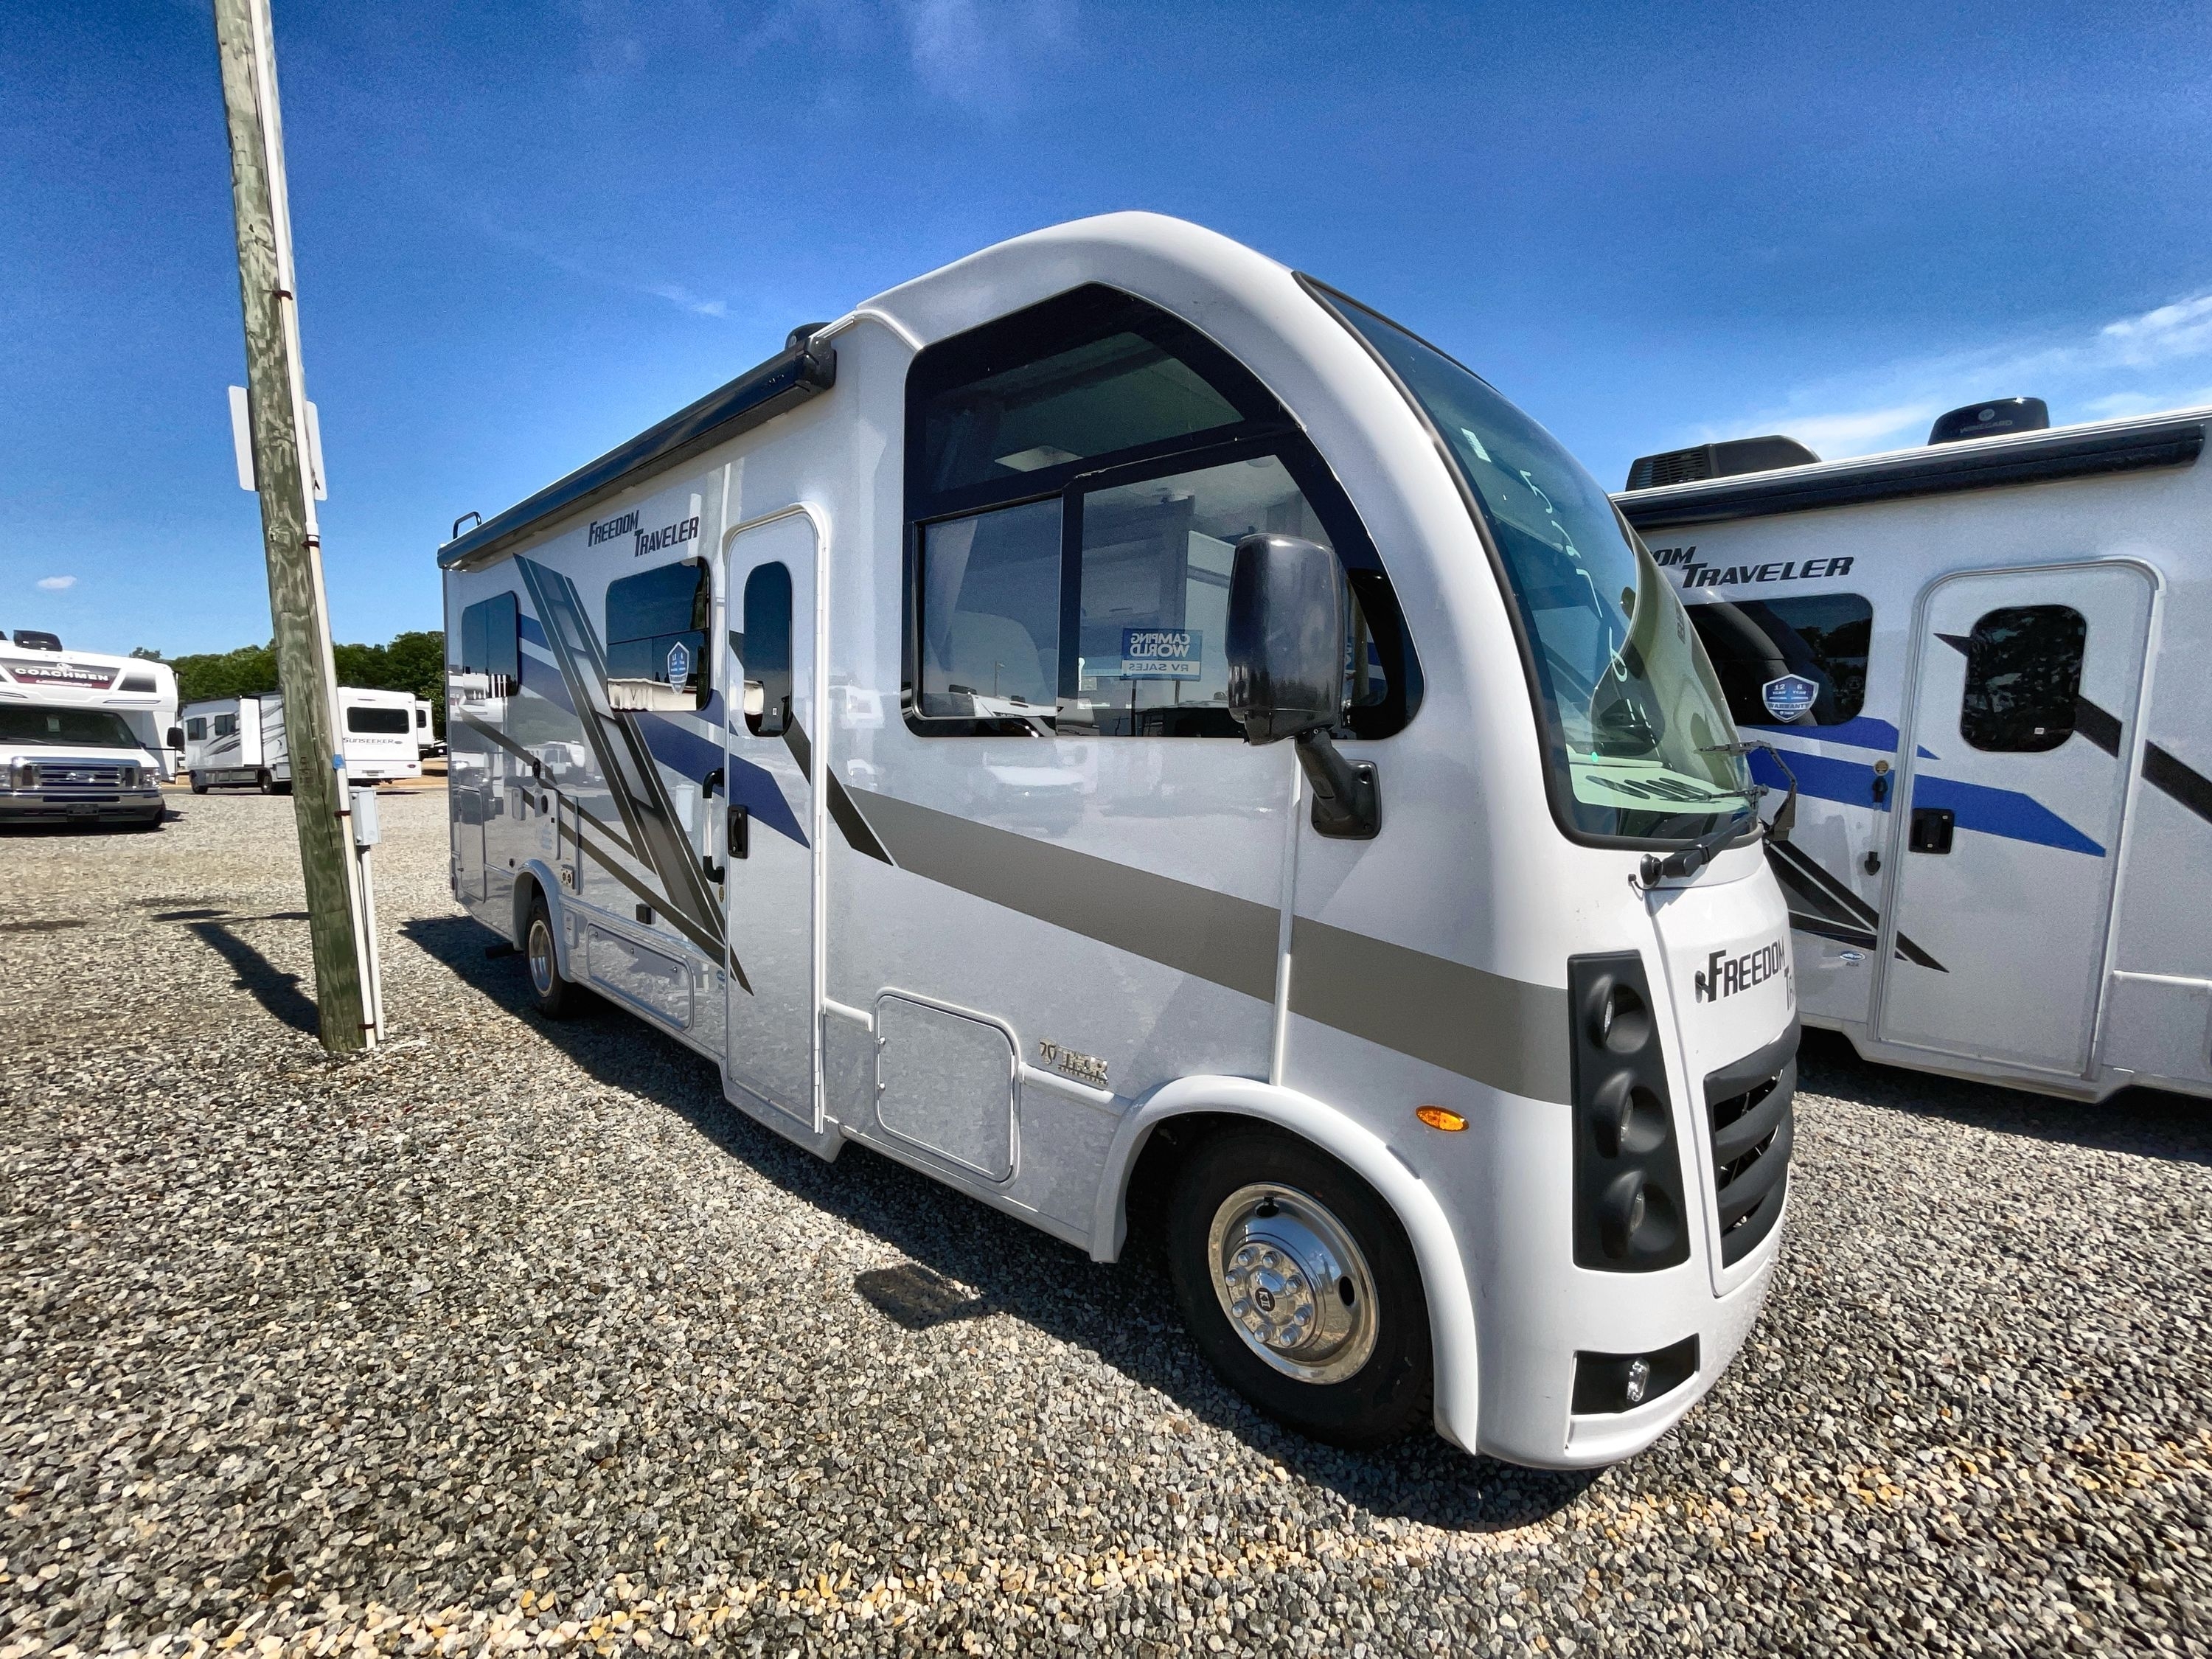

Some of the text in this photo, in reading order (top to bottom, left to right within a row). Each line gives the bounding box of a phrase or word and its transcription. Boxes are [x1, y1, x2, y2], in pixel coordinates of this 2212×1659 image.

[588, 509, 640, 547] FREEDOM
[633, 516, 700, 557] TRAVELER
[1682, 557, 1854, 588] TRAVELER
[15, 667, 108, 681] COACHMEN
[1707, 935, 1786, 1003] FREEDOM
